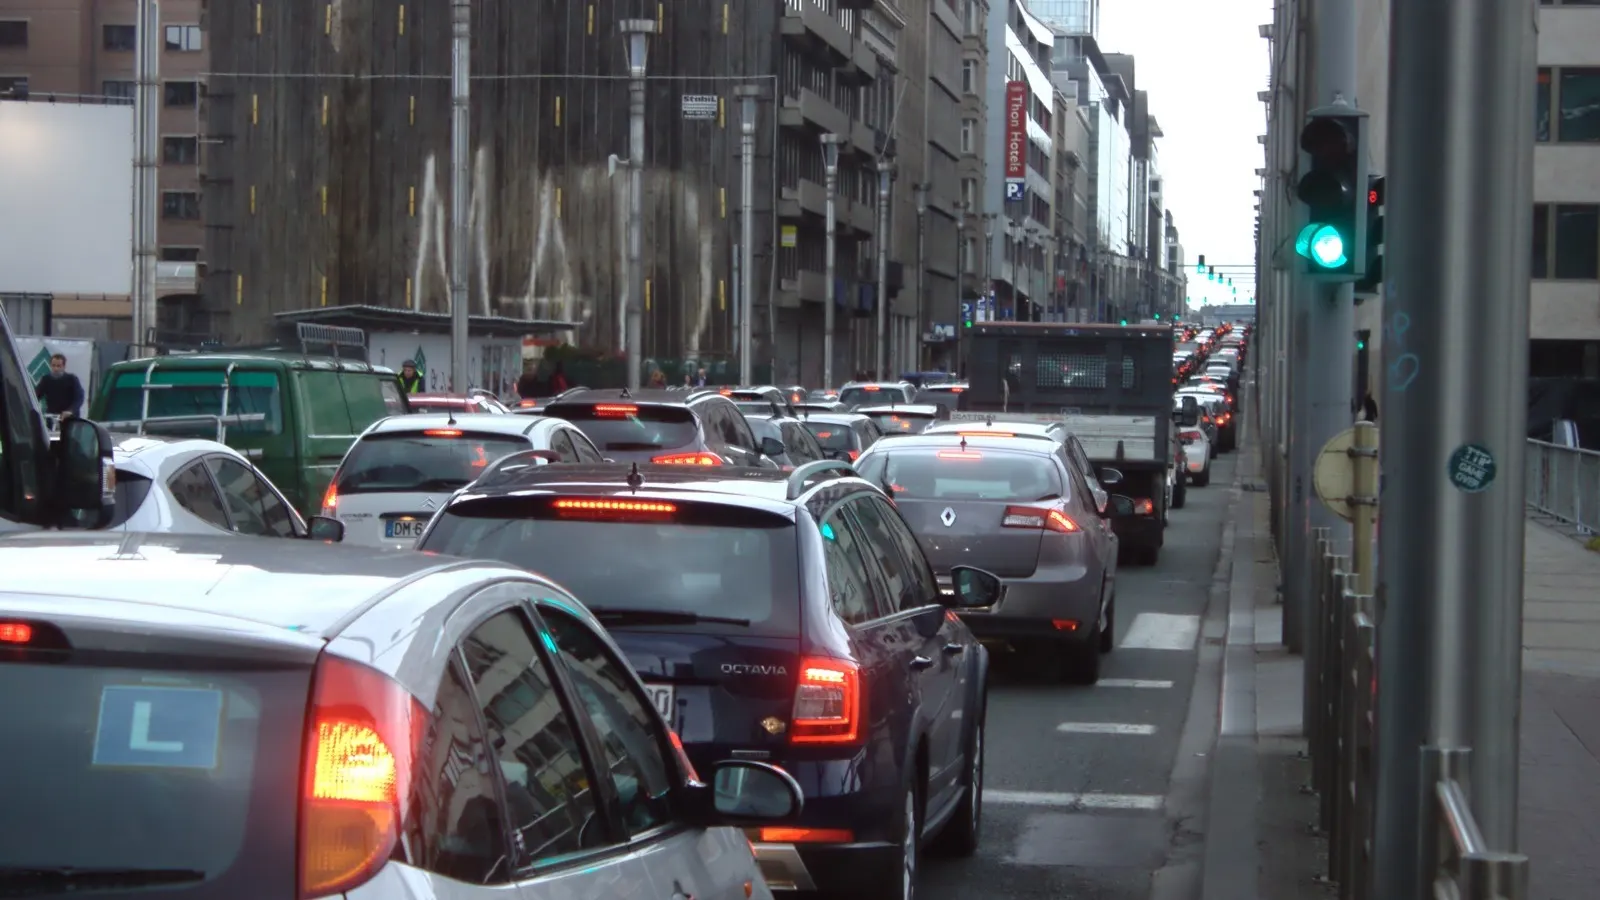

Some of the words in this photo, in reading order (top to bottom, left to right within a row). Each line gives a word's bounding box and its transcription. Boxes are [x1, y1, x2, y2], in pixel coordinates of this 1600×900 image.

[1011, 95, 1022, 127] Thon
[1010, 132, 1022, 172] Hotels
[1007, 183, 1019, 197] P
[720, 663, 788, 676] OCTAVIA
[130, 701, 184, 752] L
